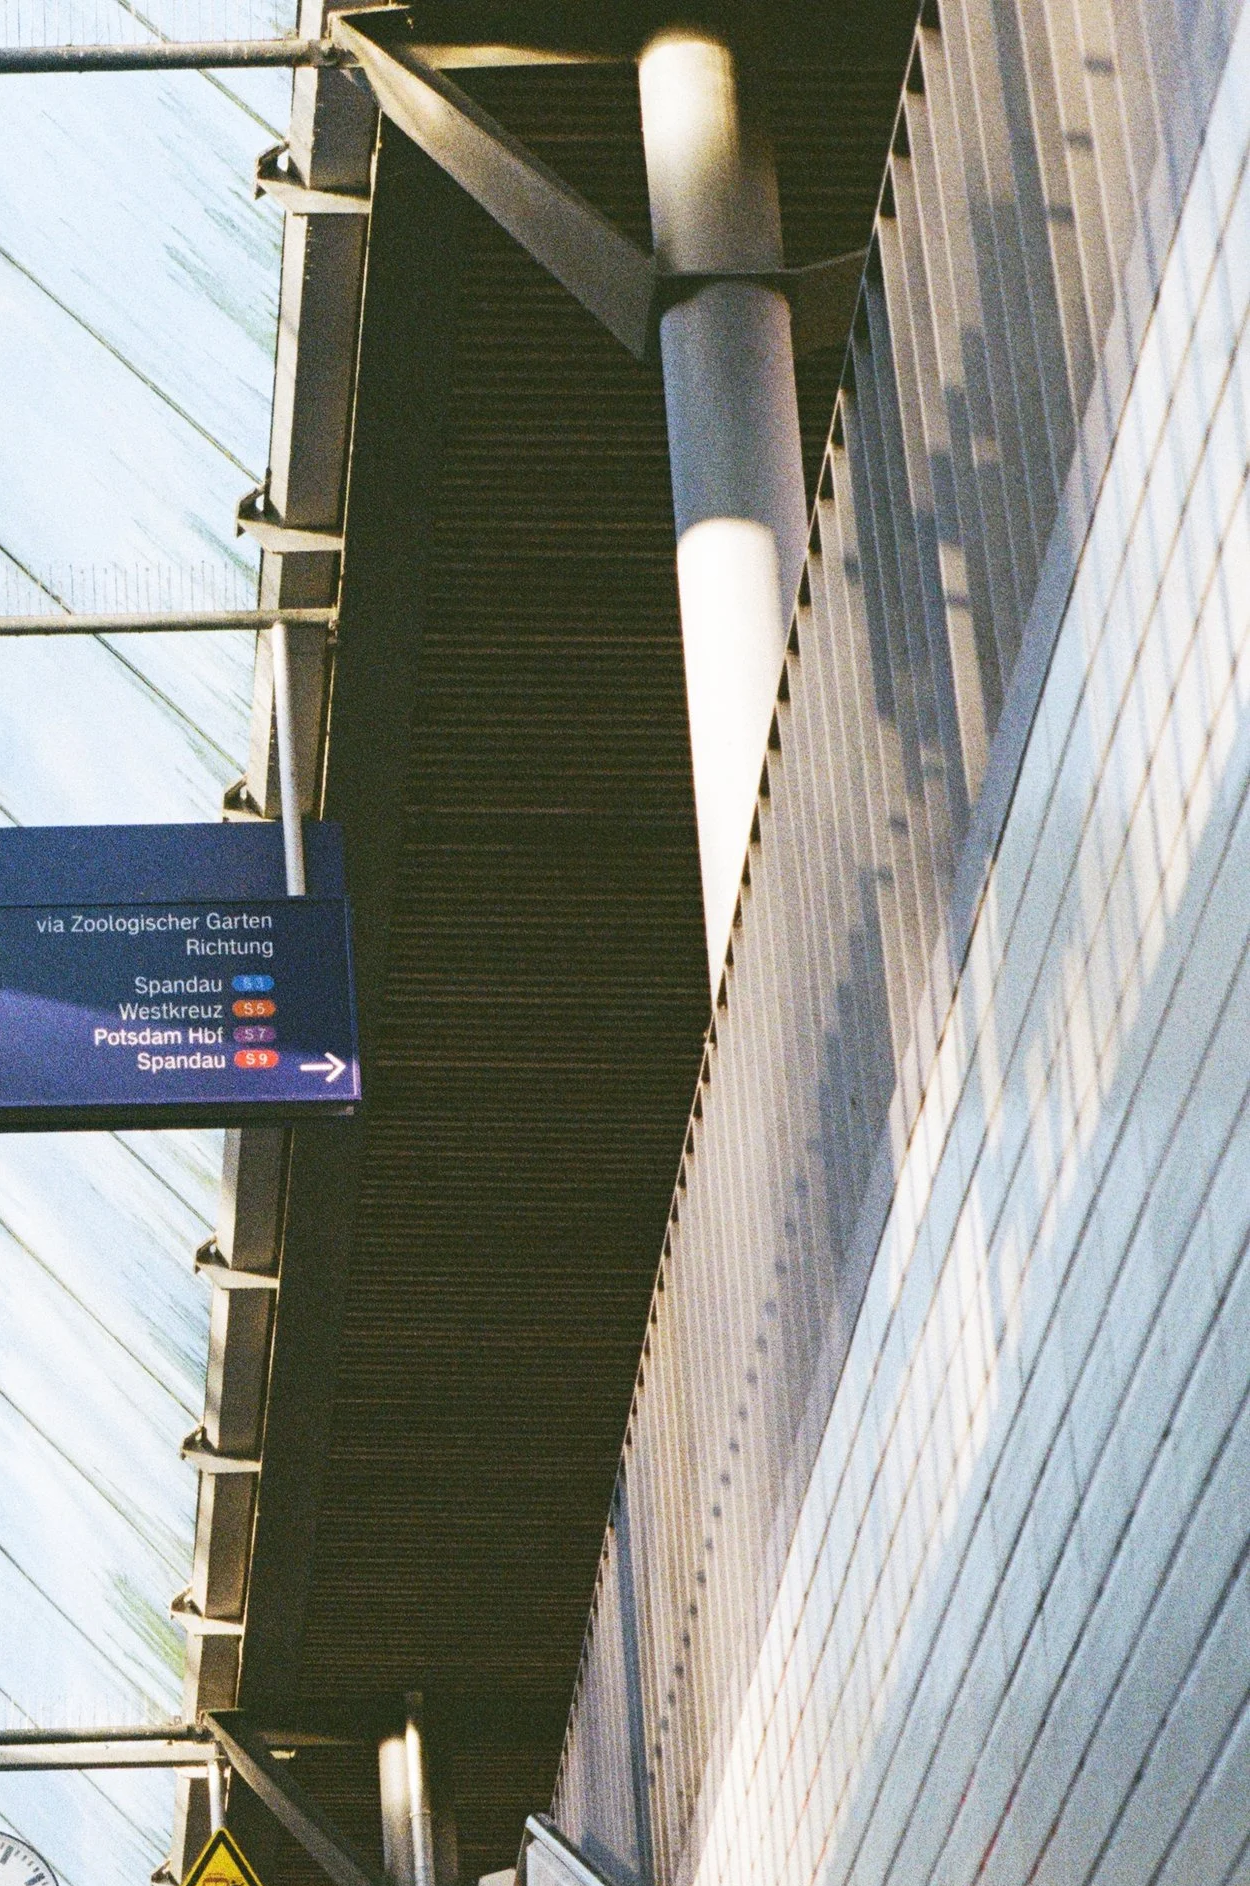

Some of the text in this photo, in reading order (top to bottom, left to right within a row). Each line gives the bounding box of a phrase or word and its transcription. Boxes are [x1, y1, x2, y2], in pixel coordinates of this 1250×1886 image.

[36, 912, 273, 935] via Zoologischer Garten
[186, 938, 274, 958] Richtung
[134, 976, 223, 996] Spandau
[119, 1002, 224, 1020] Westkreuz
[94, 1028, 182, 1046] Potsdam
[188, 1026, 225, 1044] Hbf
[136, 1053, 227, 1073] Spandau
